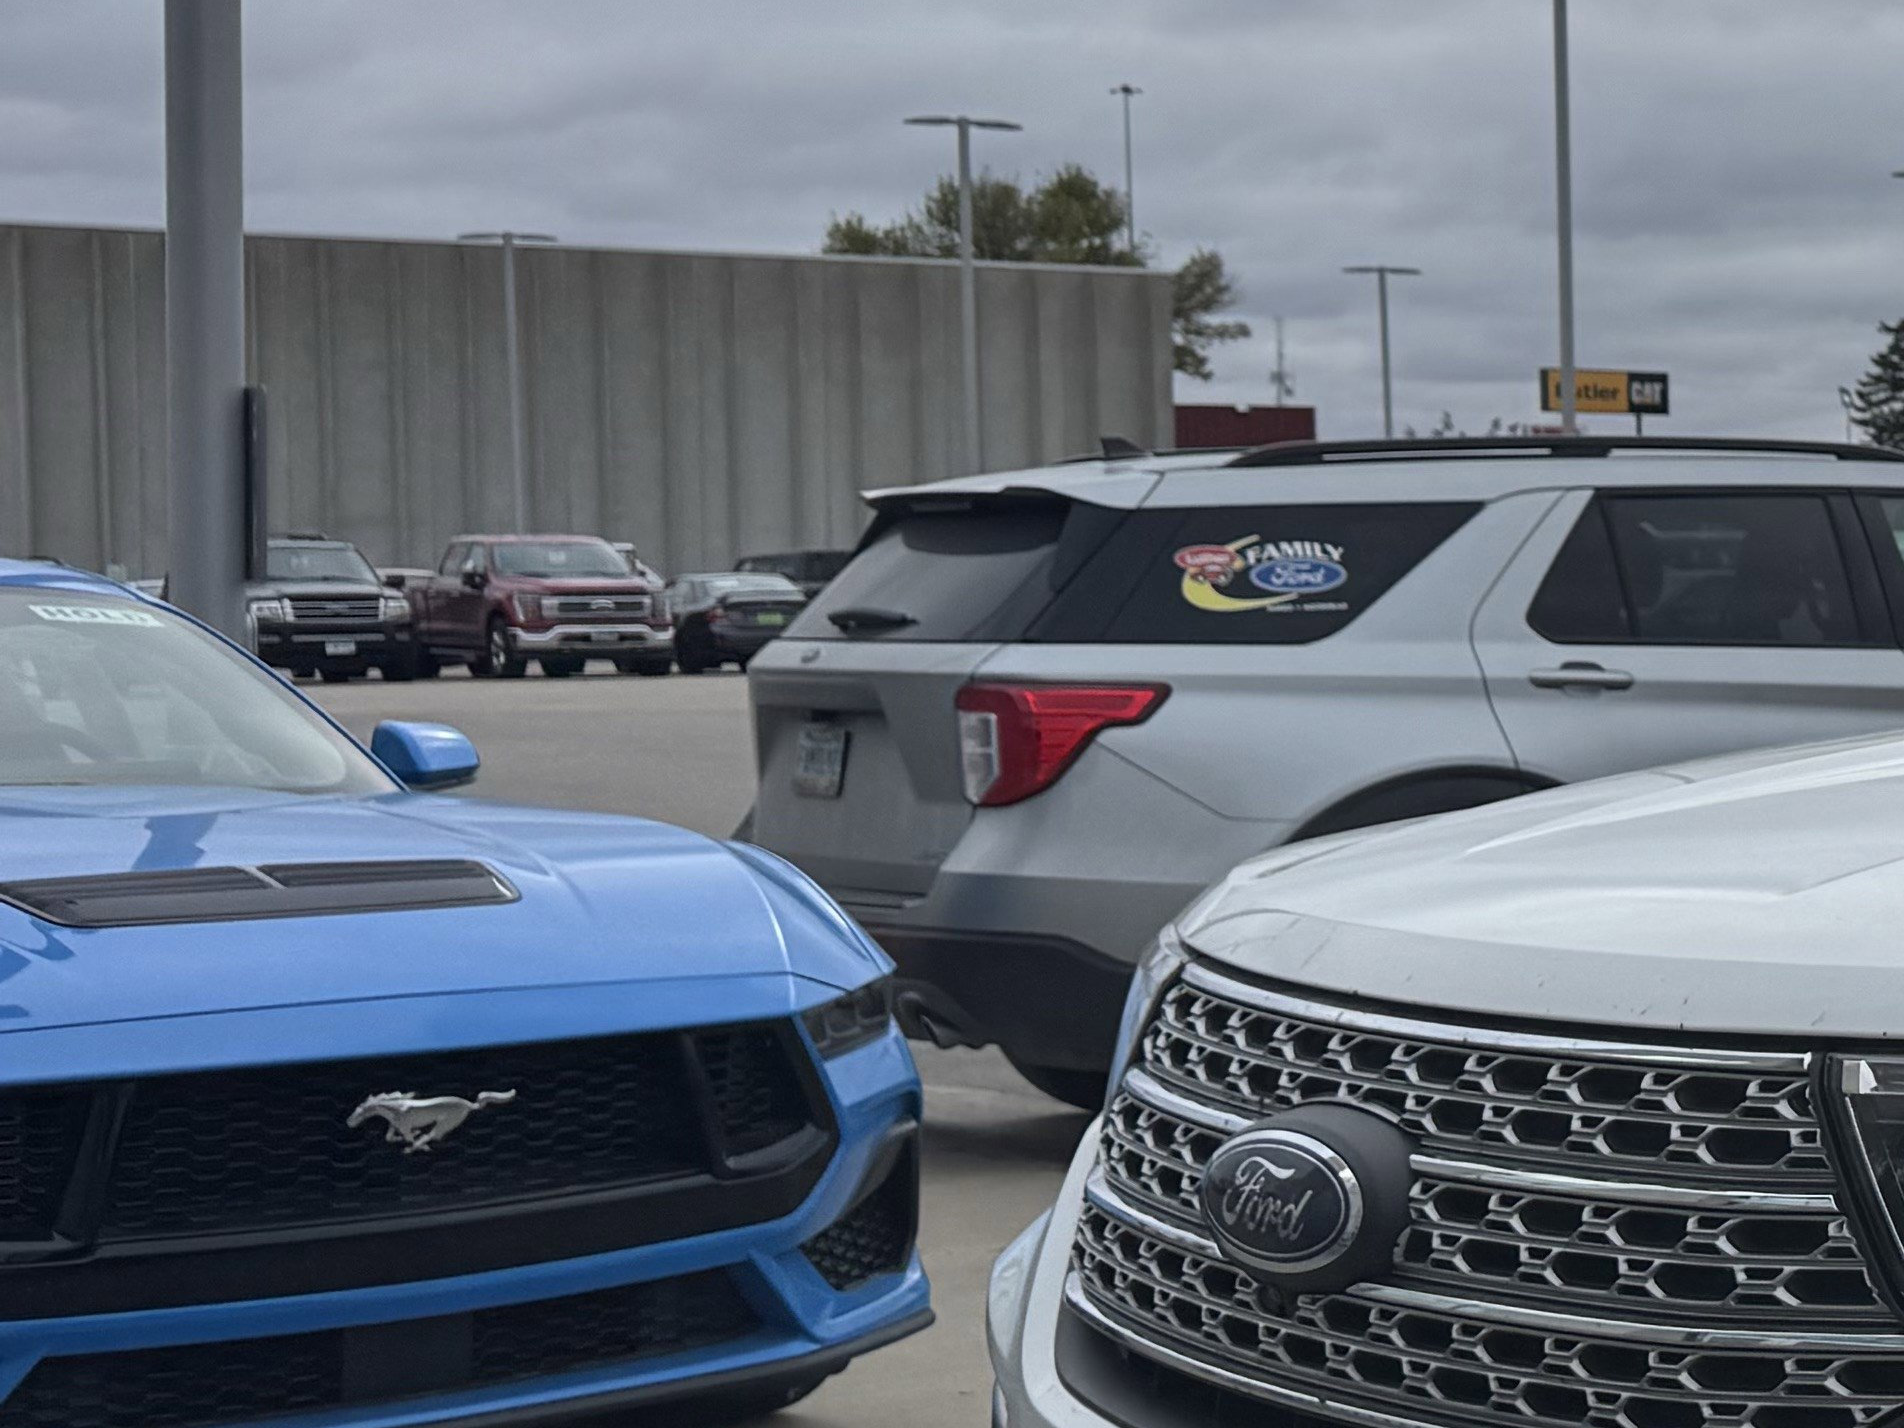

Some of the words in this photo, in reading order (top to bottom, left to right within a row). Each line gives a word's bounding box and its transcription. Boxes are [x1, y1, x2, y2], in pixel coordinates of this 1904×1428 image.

[1631, 380, 1663, 406] CAT
[1246, 541, 1344, 565] FAMILY
[1222, 1156, 1314, 1241] Ford
